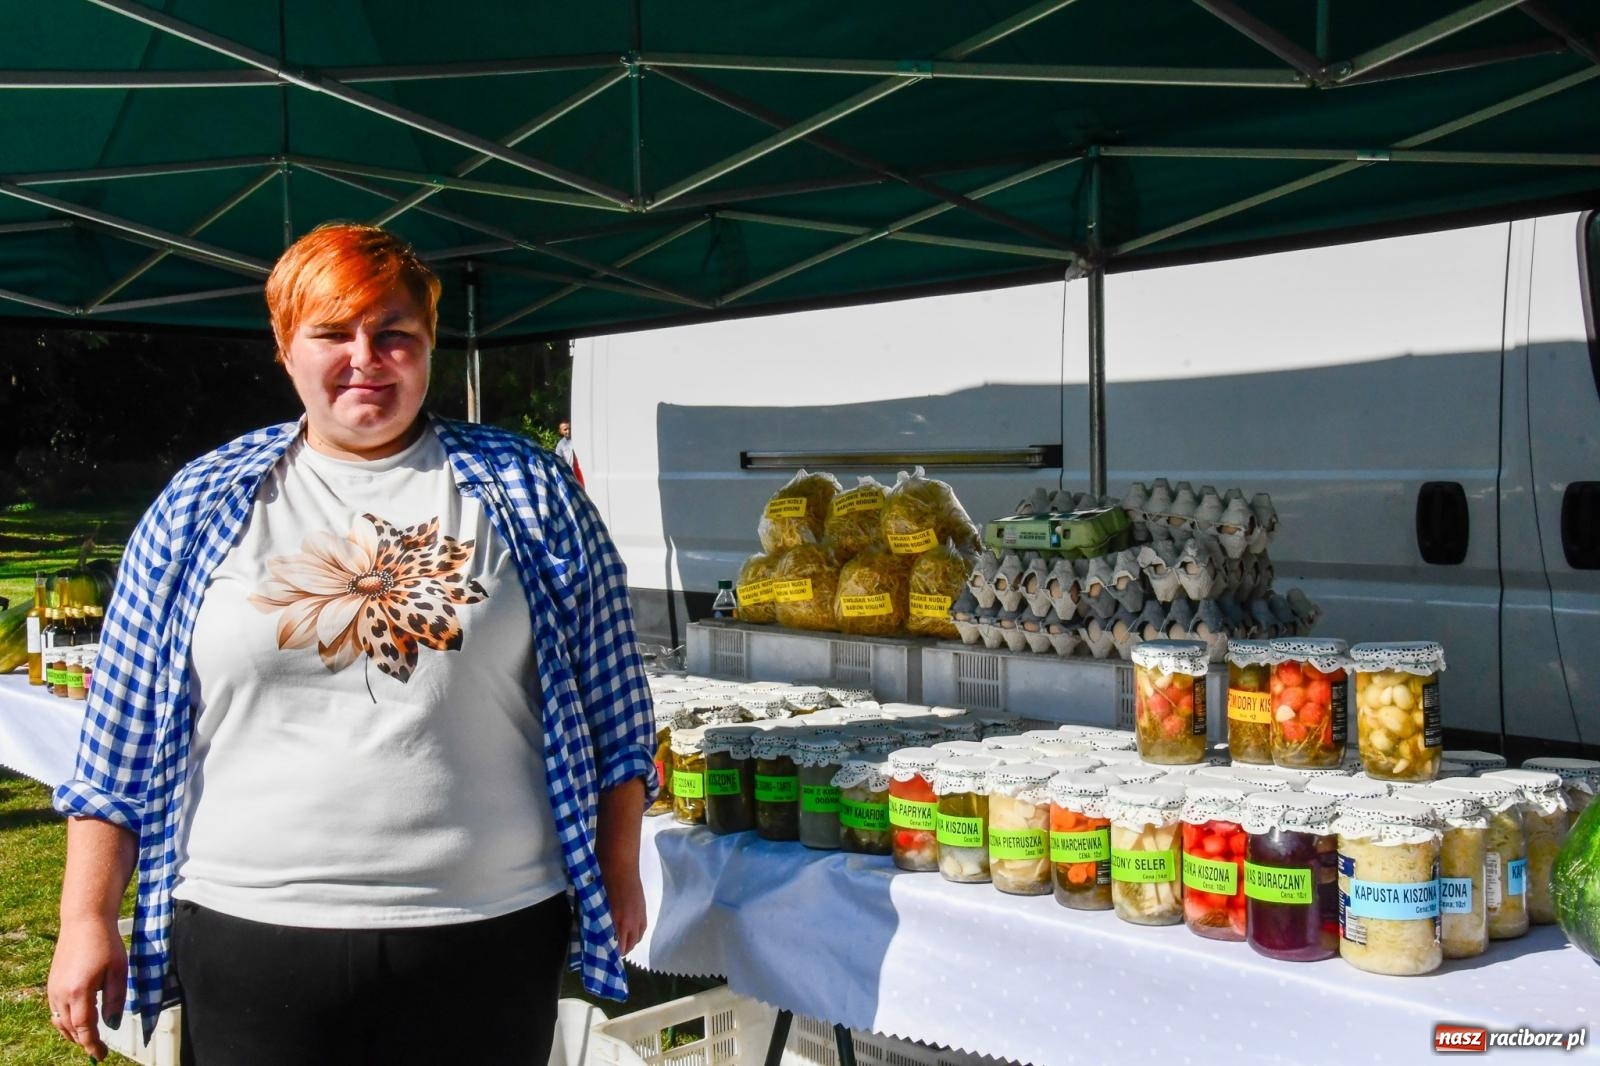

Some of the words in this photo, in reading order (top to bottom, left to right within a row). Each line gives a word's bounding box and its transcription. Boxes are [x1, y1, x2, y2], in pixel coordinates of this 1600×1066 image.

[928, 596, 947, 604] NUDLE
[854, 807, 886, 821] KALAFIOR
[899, 803, 933, 820] PAPRYKA
[945, 820, 979, 836] KISZONA
[1002, 835, 1042, 849] PIETRUSZKA
[1060, 836, 1102, 851] MARCHEWKA
[1135, 858, 1166, 871] SELER
[1197, 864, 1230, 883] KISZONA
[1257, 871, 1306, 890] BURACZANY
[1354, 884, 1400, 904] KAPUSTA
[1403, 886, 1437, 904] KISZONA
